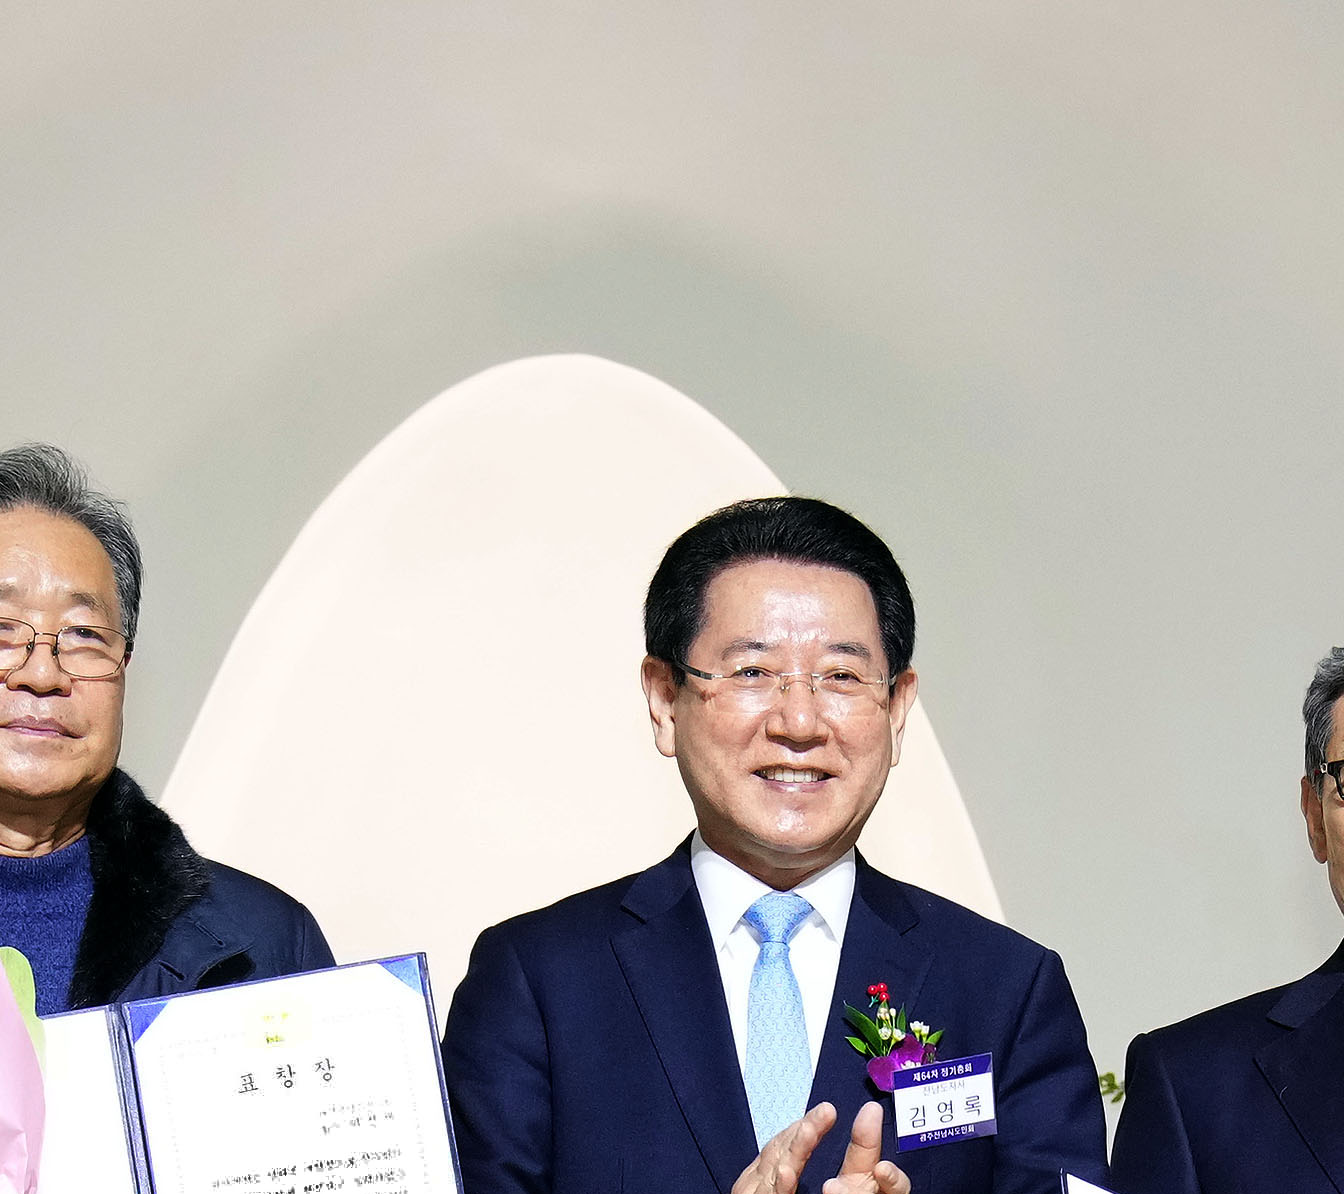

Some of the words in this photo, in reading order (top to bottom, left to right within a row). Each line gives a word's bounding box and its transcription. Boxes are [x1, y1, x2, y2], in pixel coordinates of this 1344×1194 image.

[913, 1070, 938, 1081] 제64차
[941, 1063, 972, 1077] 정기총회
[920, 1125, 975, 1142] 광주전남시도민회
